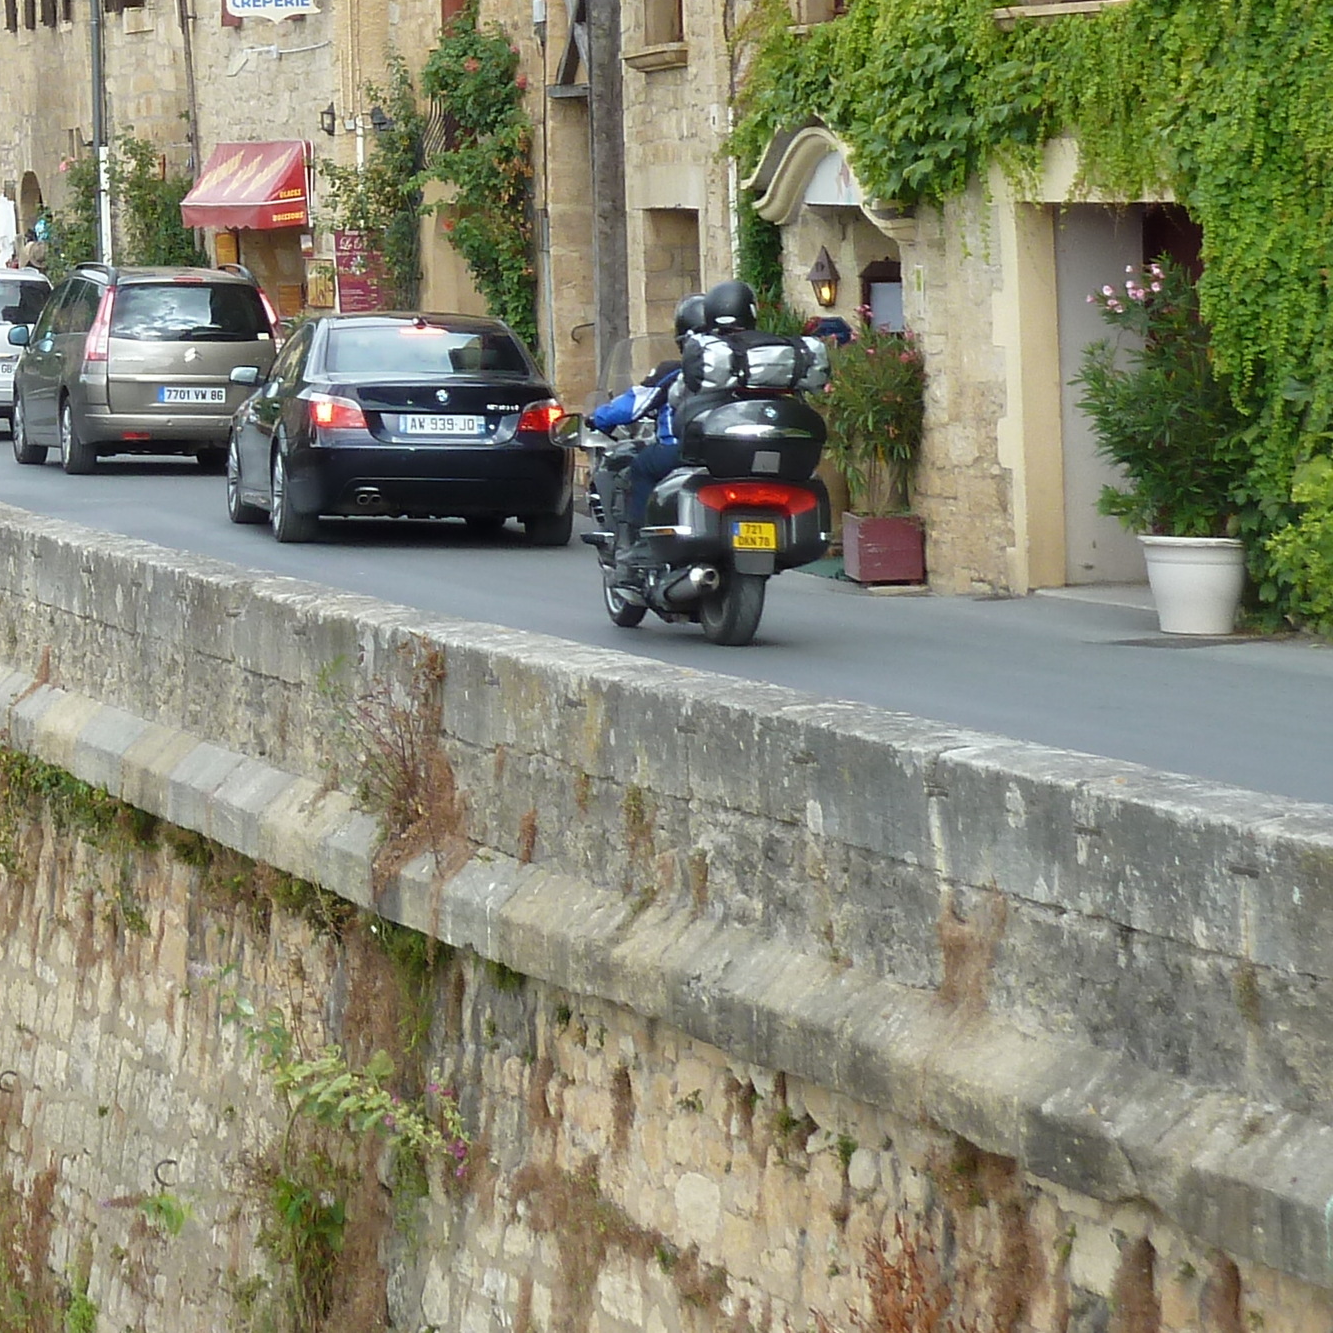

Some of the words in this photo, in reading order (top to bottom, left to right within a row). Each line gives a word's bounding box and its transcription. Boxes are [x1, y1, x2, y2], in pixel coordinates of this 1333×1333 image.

[166, 389, 190, 400] 7701
[194, 389, 207, 400] VW
[211, 388, 224, 400] 86
[745, 524, 762, 535] 721
